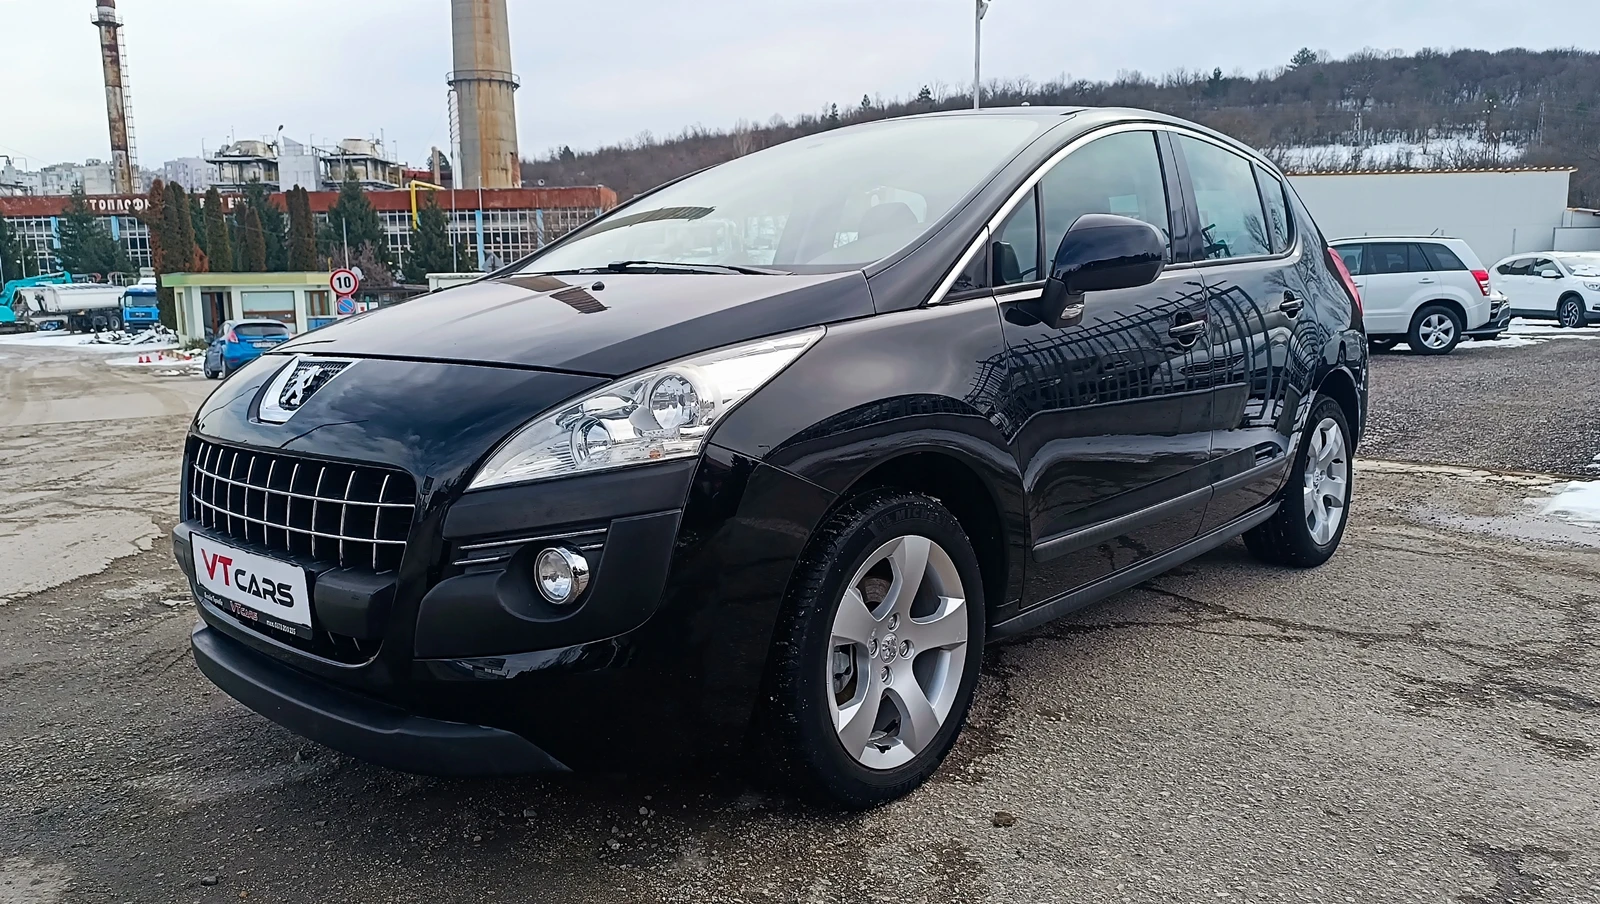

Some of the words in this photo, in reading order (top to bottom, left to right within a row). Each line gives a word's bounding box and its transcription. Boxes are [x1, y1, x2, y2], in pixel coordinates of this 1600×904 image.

[336, 276, 351, 288] 10
[201, 548, 232, 586] VT
[235, 569, 294, 608] CARS
